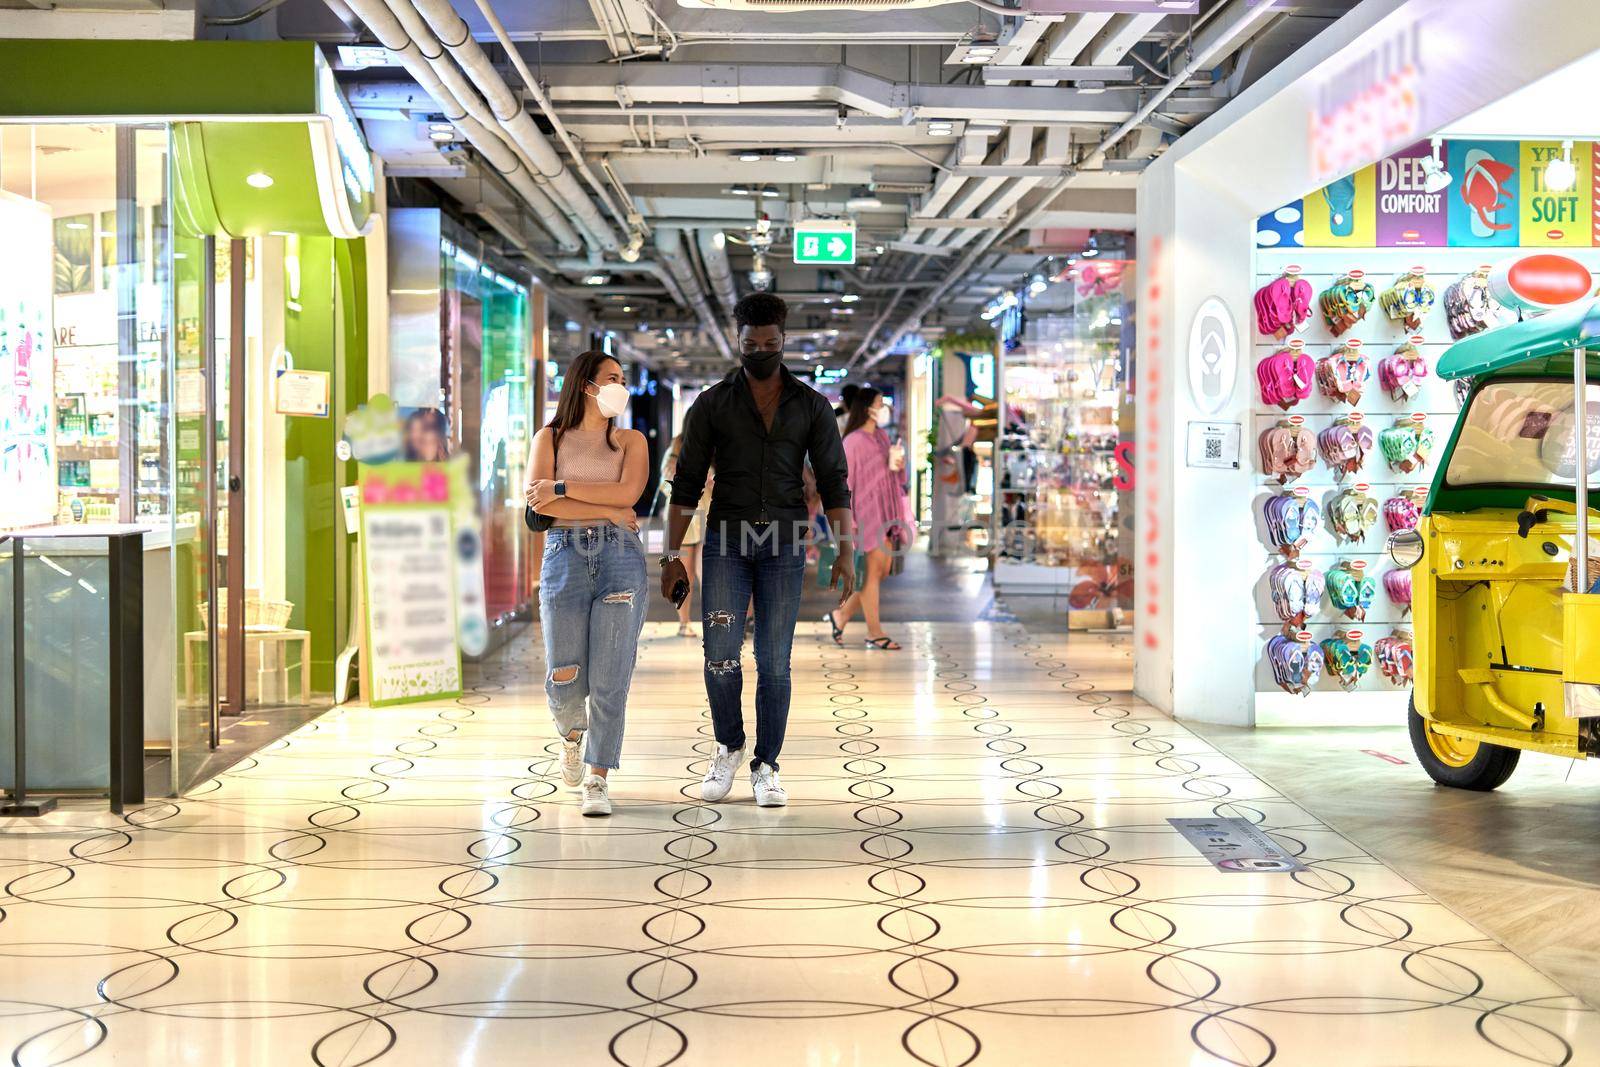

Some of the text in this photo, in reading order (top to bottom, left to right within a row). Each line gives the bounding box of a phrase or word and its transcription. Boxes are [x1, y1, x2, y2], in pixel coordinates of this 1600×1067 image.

[1380, 157, 1426, 191] DEE
[1380, 194, 1441, 213] COMFORT
[1531, 196, 1579, 223] SOFT
